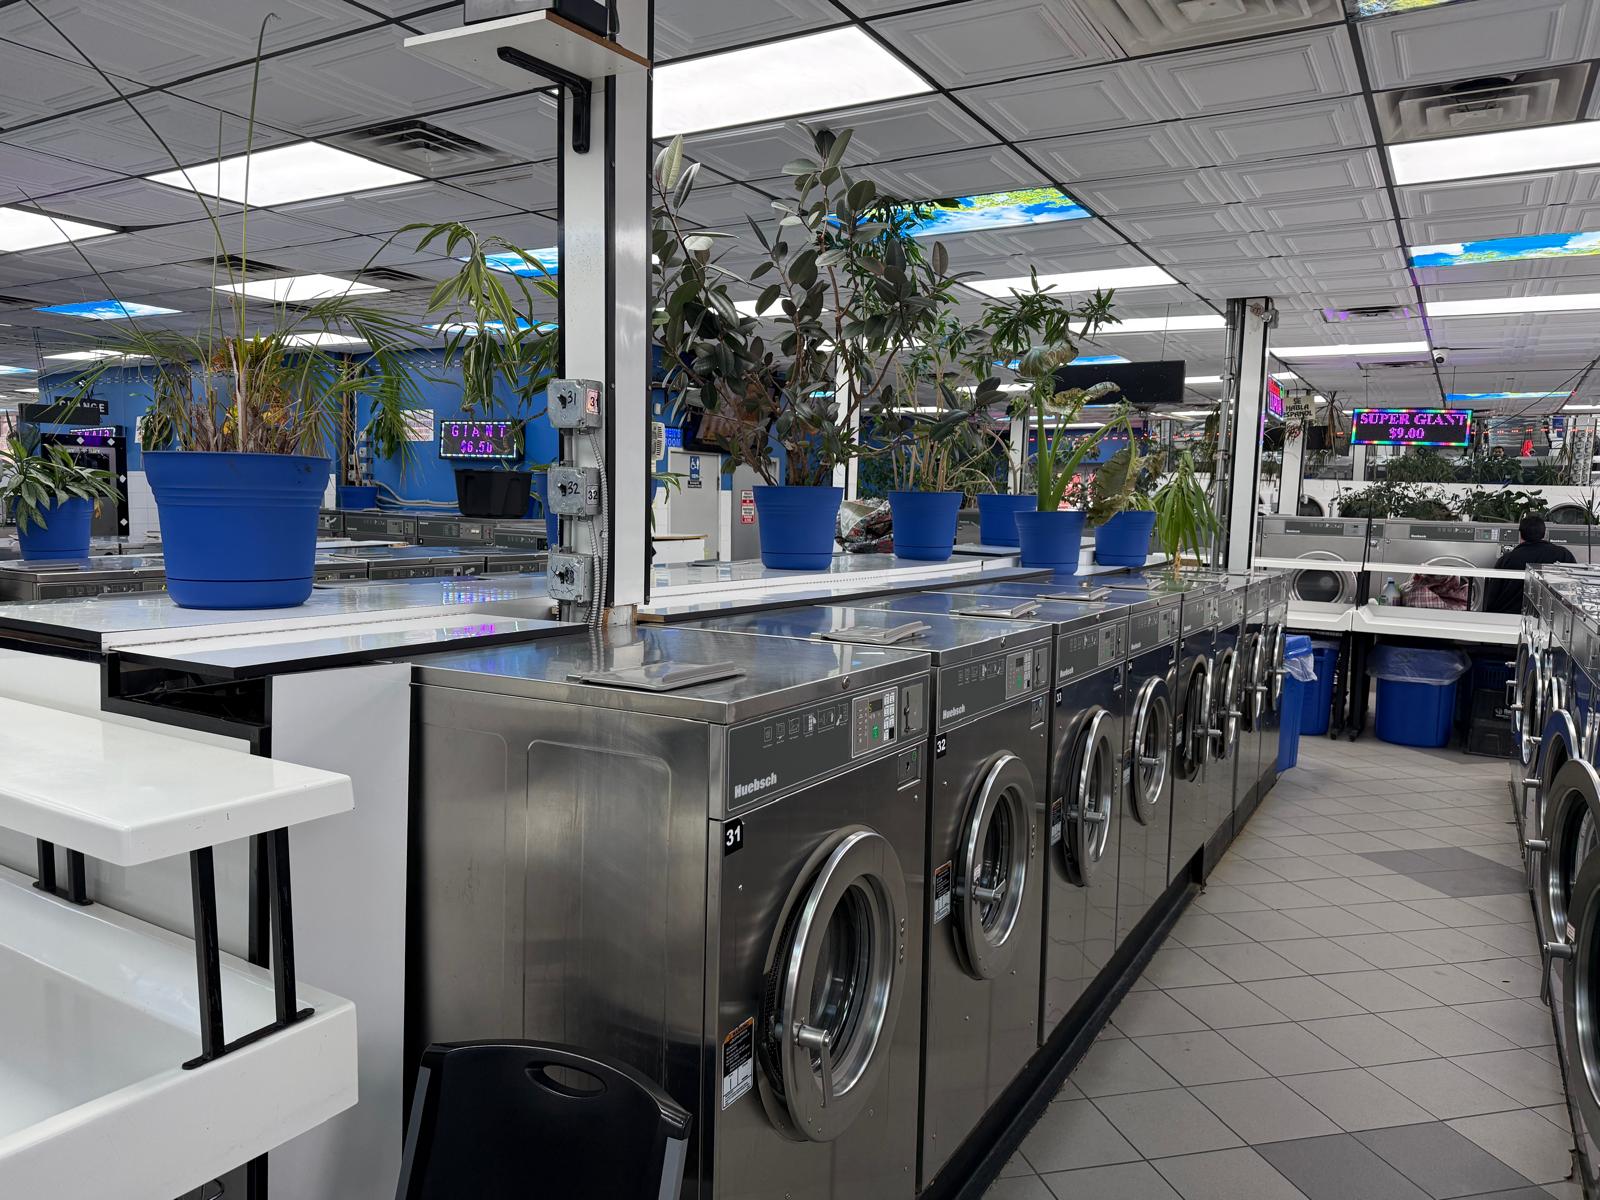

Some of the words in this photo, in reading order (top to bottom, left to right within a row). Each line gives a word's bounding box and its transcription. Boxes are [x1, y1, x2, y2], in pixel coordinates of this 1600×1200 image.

[567, 390, 577, 406] 31
[1360, 413, 1410, 425] SUPER
[1414, 413, 1467, 425] GIANT
[451, 424, 506, 438] GIANT
[1389, 427, 1425, 439] $9.00
[567, 480, 581, 495] 32
[587, 490, 598, 500] 32
[942, 703, 966, 720] Huebsch
[936, 738, 947, 753] 32
[734, 771, 778, 799] Huebsch
[726, 825, 741, 847] 31
